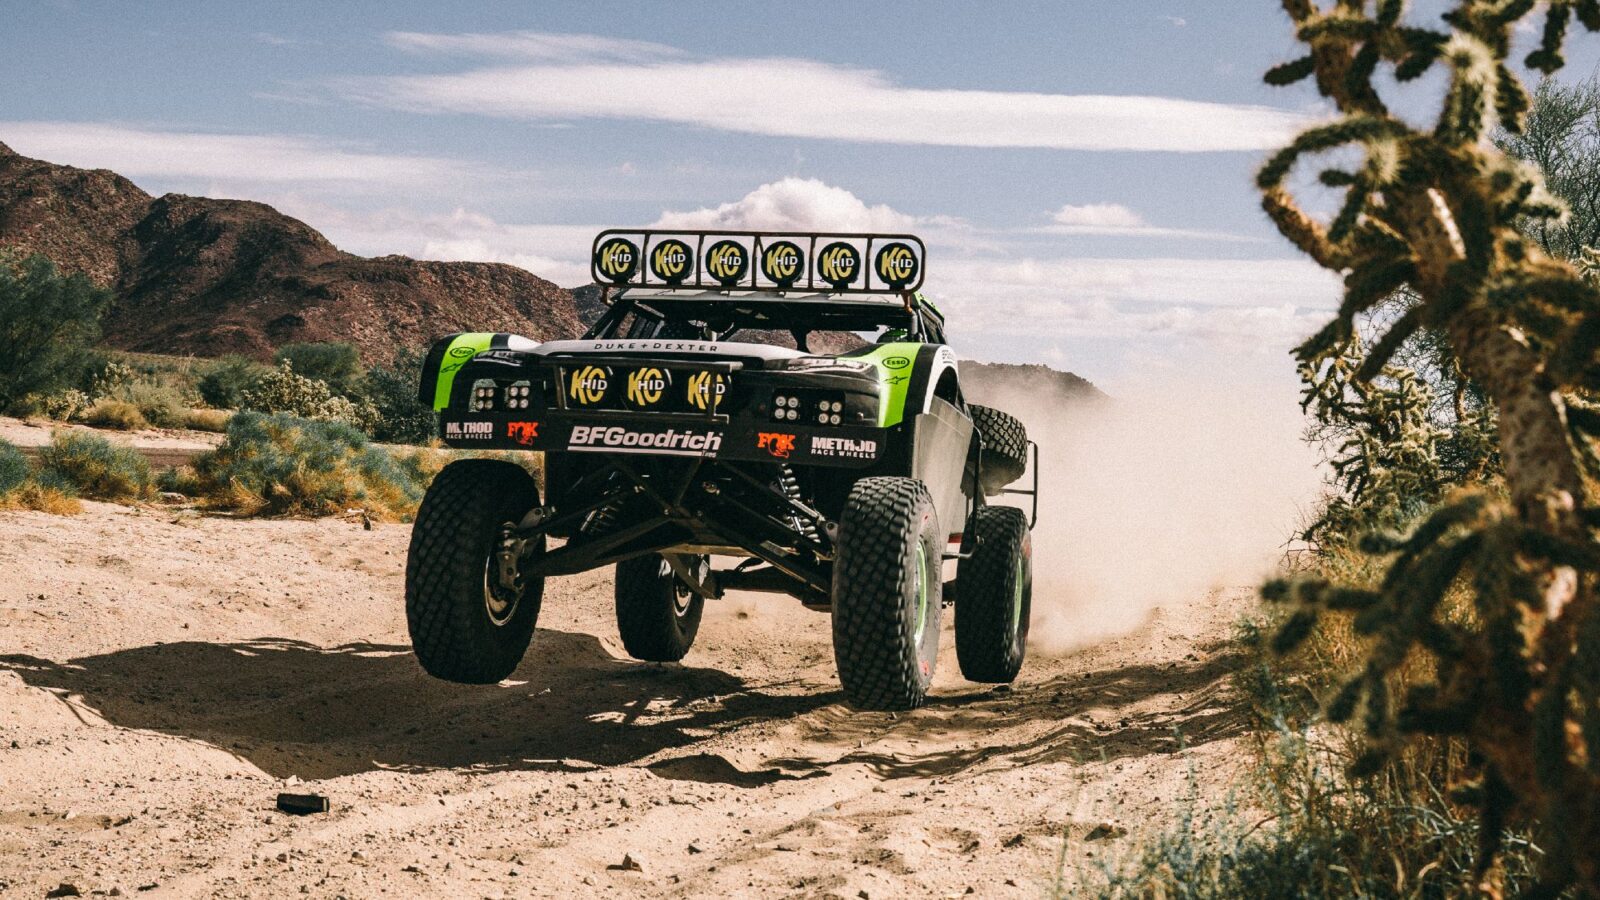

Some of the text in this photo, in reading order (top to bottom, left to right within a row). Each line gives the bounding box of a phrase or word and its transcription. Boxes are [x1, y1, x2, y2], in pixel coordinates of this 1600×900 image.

[602, 242, 630, 275] KC
[609, 253, 632, 263] HID
[655, 243, 684, 277] KC
[663, 253, 686, 264] HID
[710, 244, 740, 278] KC
[719, 255, 742, 266] HID
[766, 245, 796, 279] KC
[775, 255, 798, 266] HID
[822, 246, 853, 281] KC
[831, 257, 855, 268] HID
[881, 247, 912, 281] KC
[890, 258, 914, 268] HID
[594, 342, 635, 351] DUKE
[653, 342, 719, 352] DEXTER
[570, 365, 606, 405] KC
[581, 379, 608, 391] HID
[627, 367, 663, 406] KC
[637, 379, 665, 391] HID
[698, 383, 726, 394] HD
[507, 421, 539, 446] FOX
[569, 425, 723, 450] BFGoodrich
[757, 432, 796, 458] FOX
[838, 450, 876, 459] WHEELS
